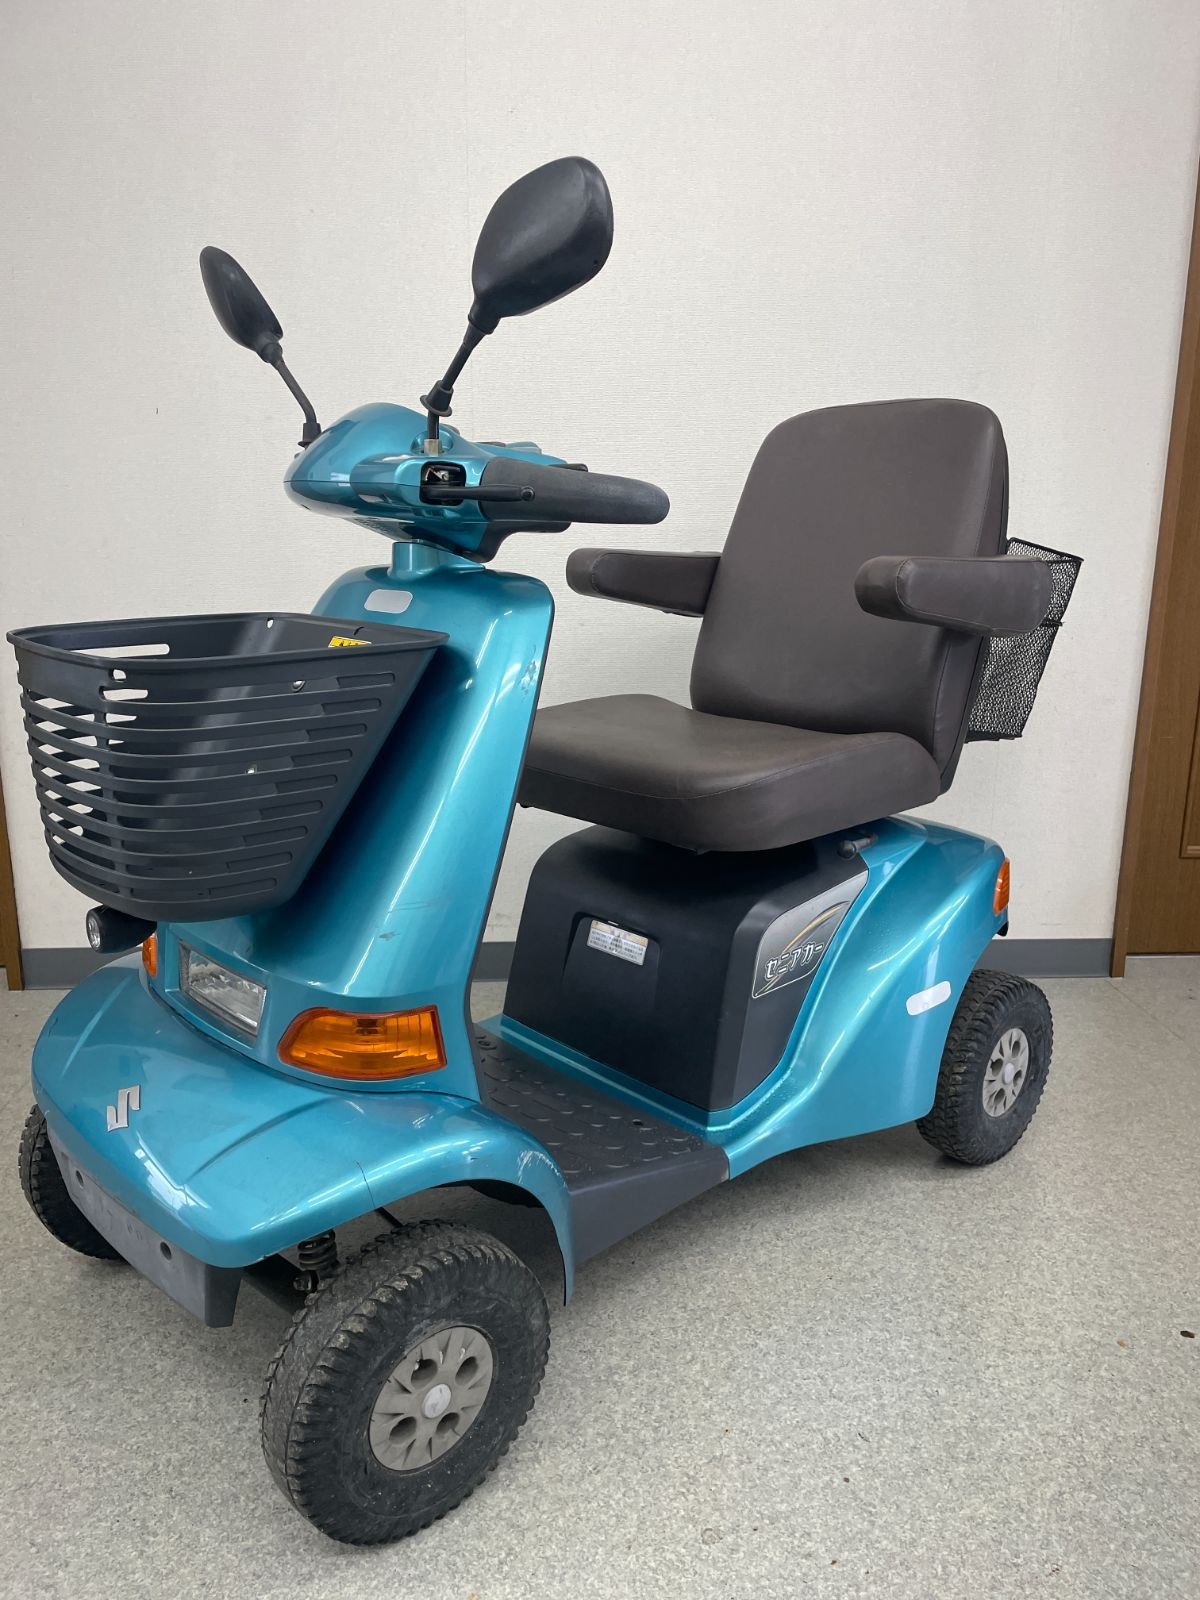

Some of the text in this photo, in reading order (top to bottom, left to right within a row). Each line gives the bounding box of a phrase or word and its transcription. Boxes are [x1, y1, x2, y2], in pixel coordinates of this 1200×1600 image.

[766, 942, 824, 979] セニアカー
